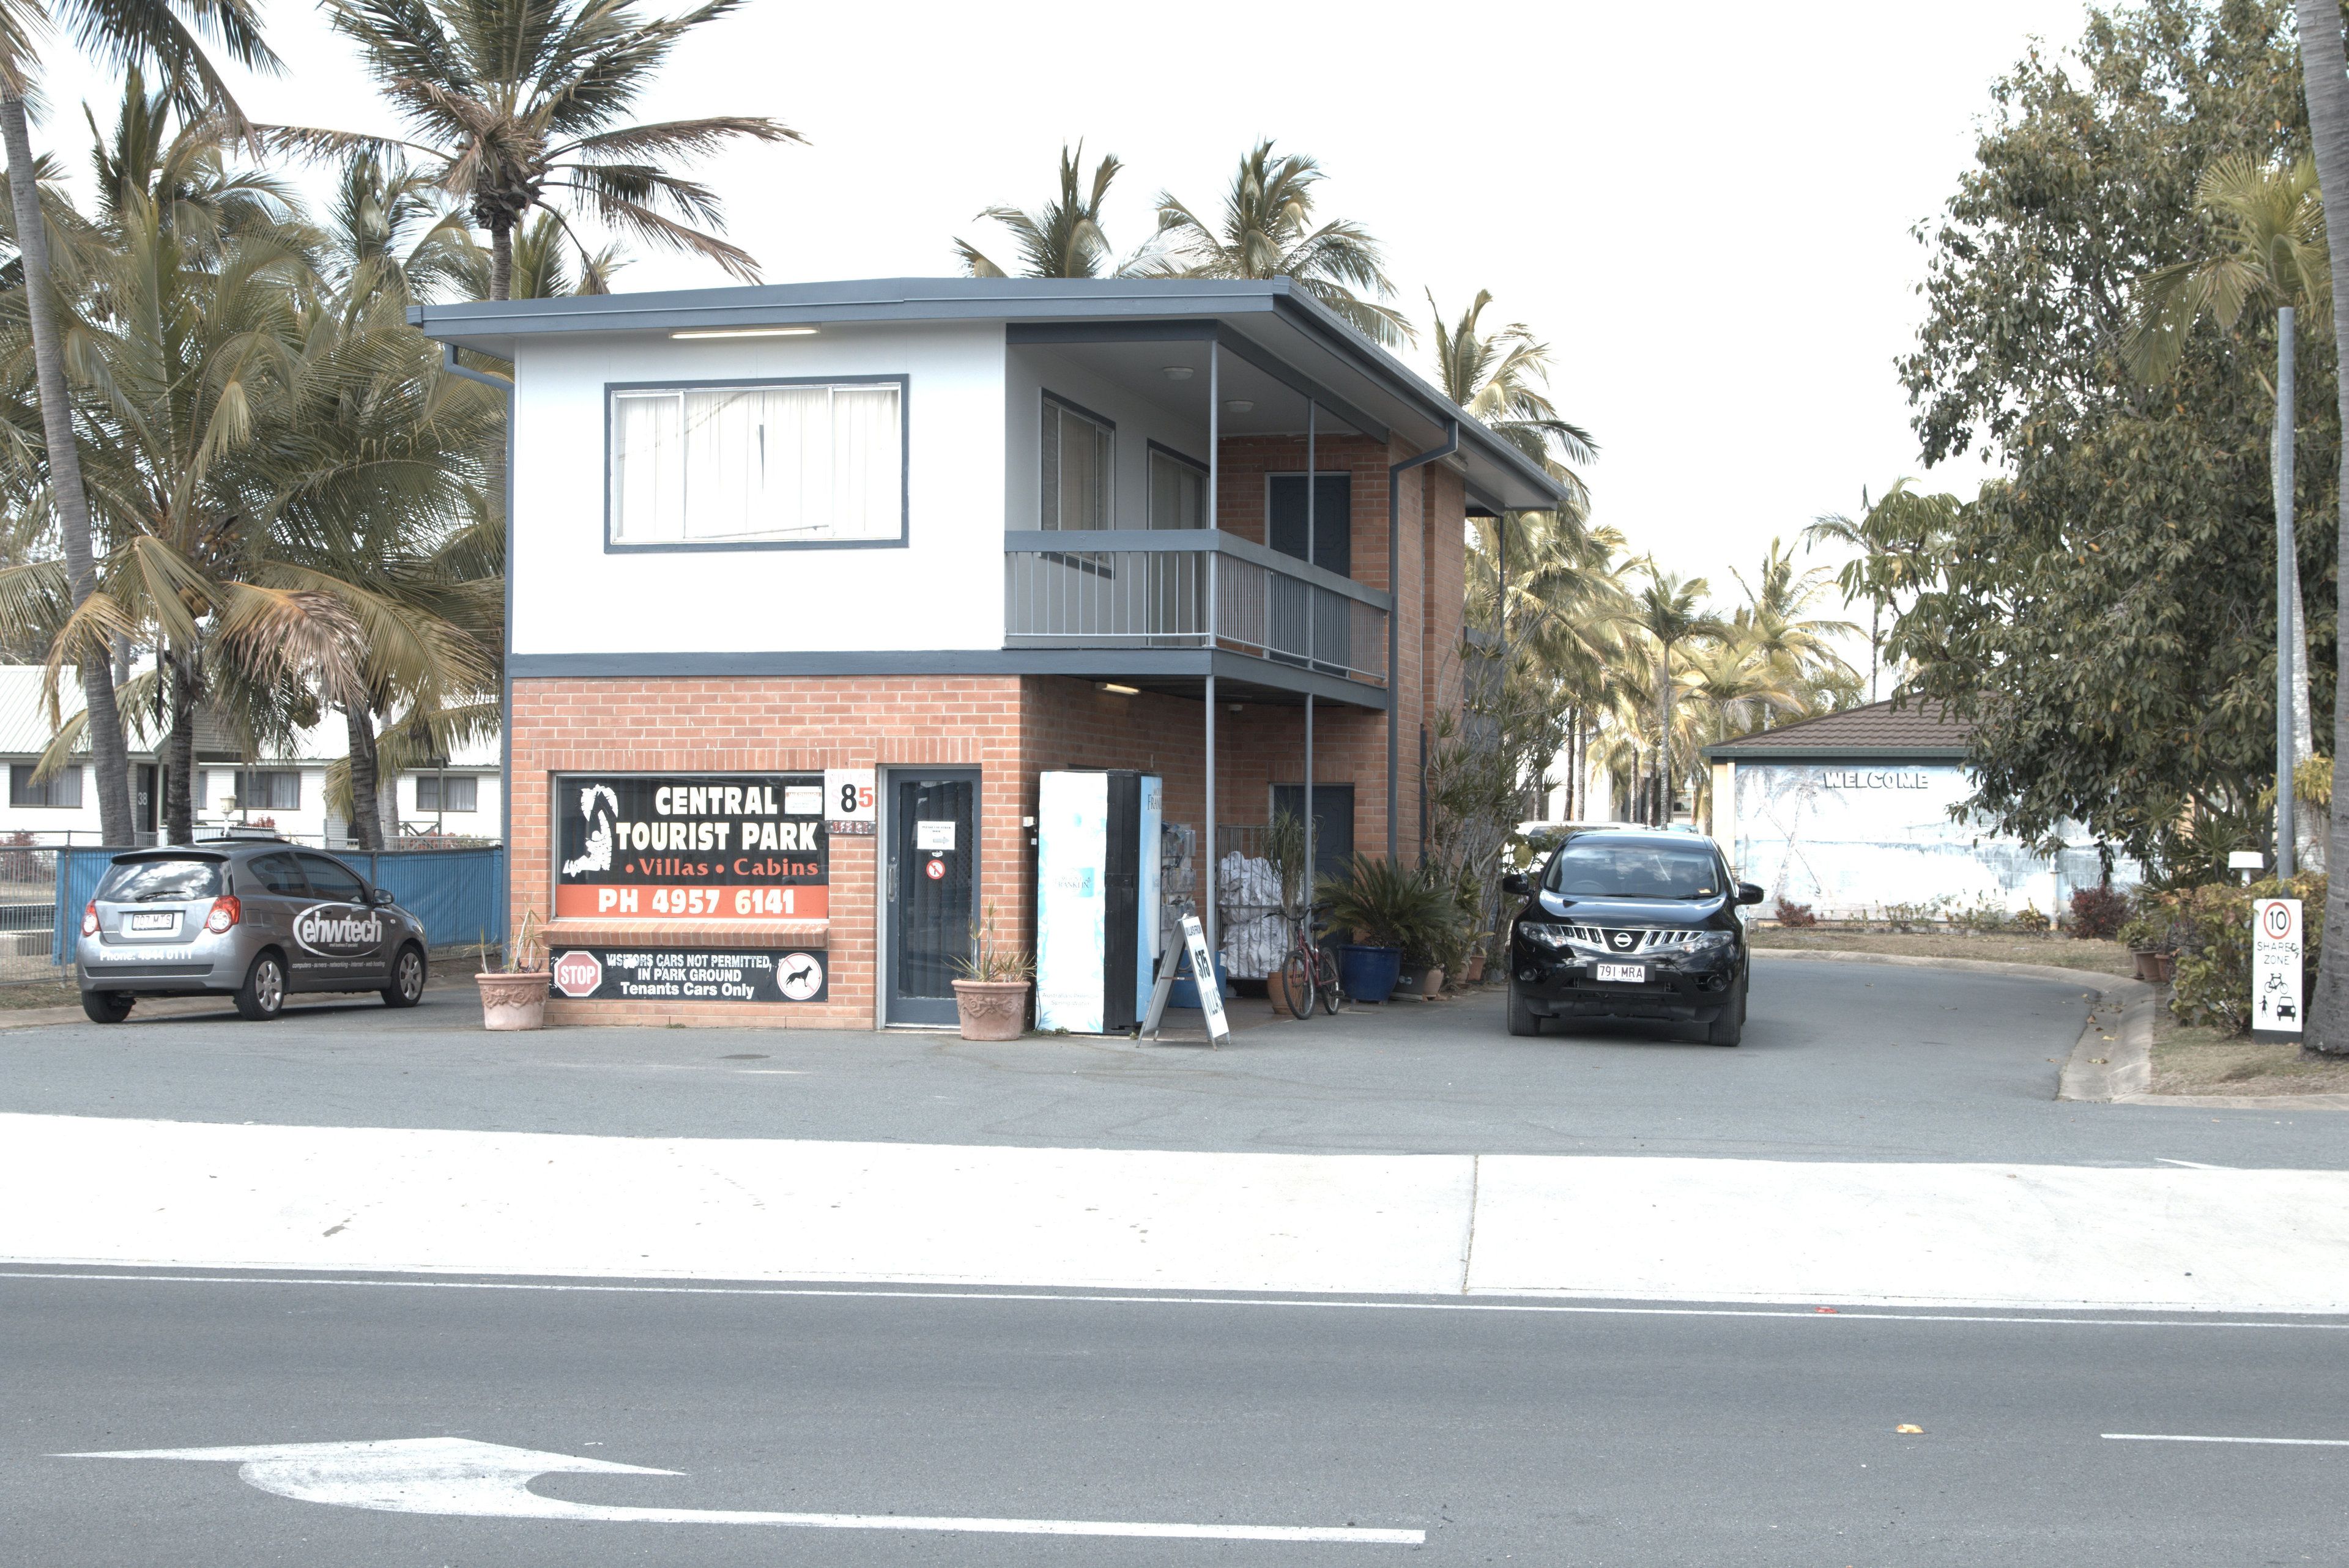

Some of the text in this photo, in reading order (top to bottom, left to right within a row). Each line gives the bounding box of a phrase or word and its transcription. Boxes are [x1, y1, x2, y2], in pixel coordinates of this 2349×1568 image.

[1824, 772, 1928, 789] WELCOME
[138, 792, 148, 805] 38
[655, 786, 777, 815] CENTRAL
[841, 784, 874, 813] 85
[833, 821, 869, 834] OFFICE
[616, 823, 818, 851] TOURIST PARK
[639, 857, 818, 876] Villas Cabins
[598, 889, 795, 914] PH 4957 6141
[135, 914, 171, 925] 707 MTS
[302, 911, 382, 942] ehwtech
[2269, 911, 2287, 930] 10
[100, 950, 136, 961] Phone:
[166, 949, 192, 960] 0111
[2257, 941, 2298, 952] SHARED
[656, 954, 684, 967] CARS
[687, 955, 708, 967] NOT
[1194, 949, 1211, 980] $75
[2263, 955, 2290, 965] ZONE
[560, 965, 596, 985] STOP
[637, 969, 741, 982] IN PARK GROUND
[1600, 966, 1642, 978] 791 MRA
[620, 982, 755, 999] Tenants Cars Only
